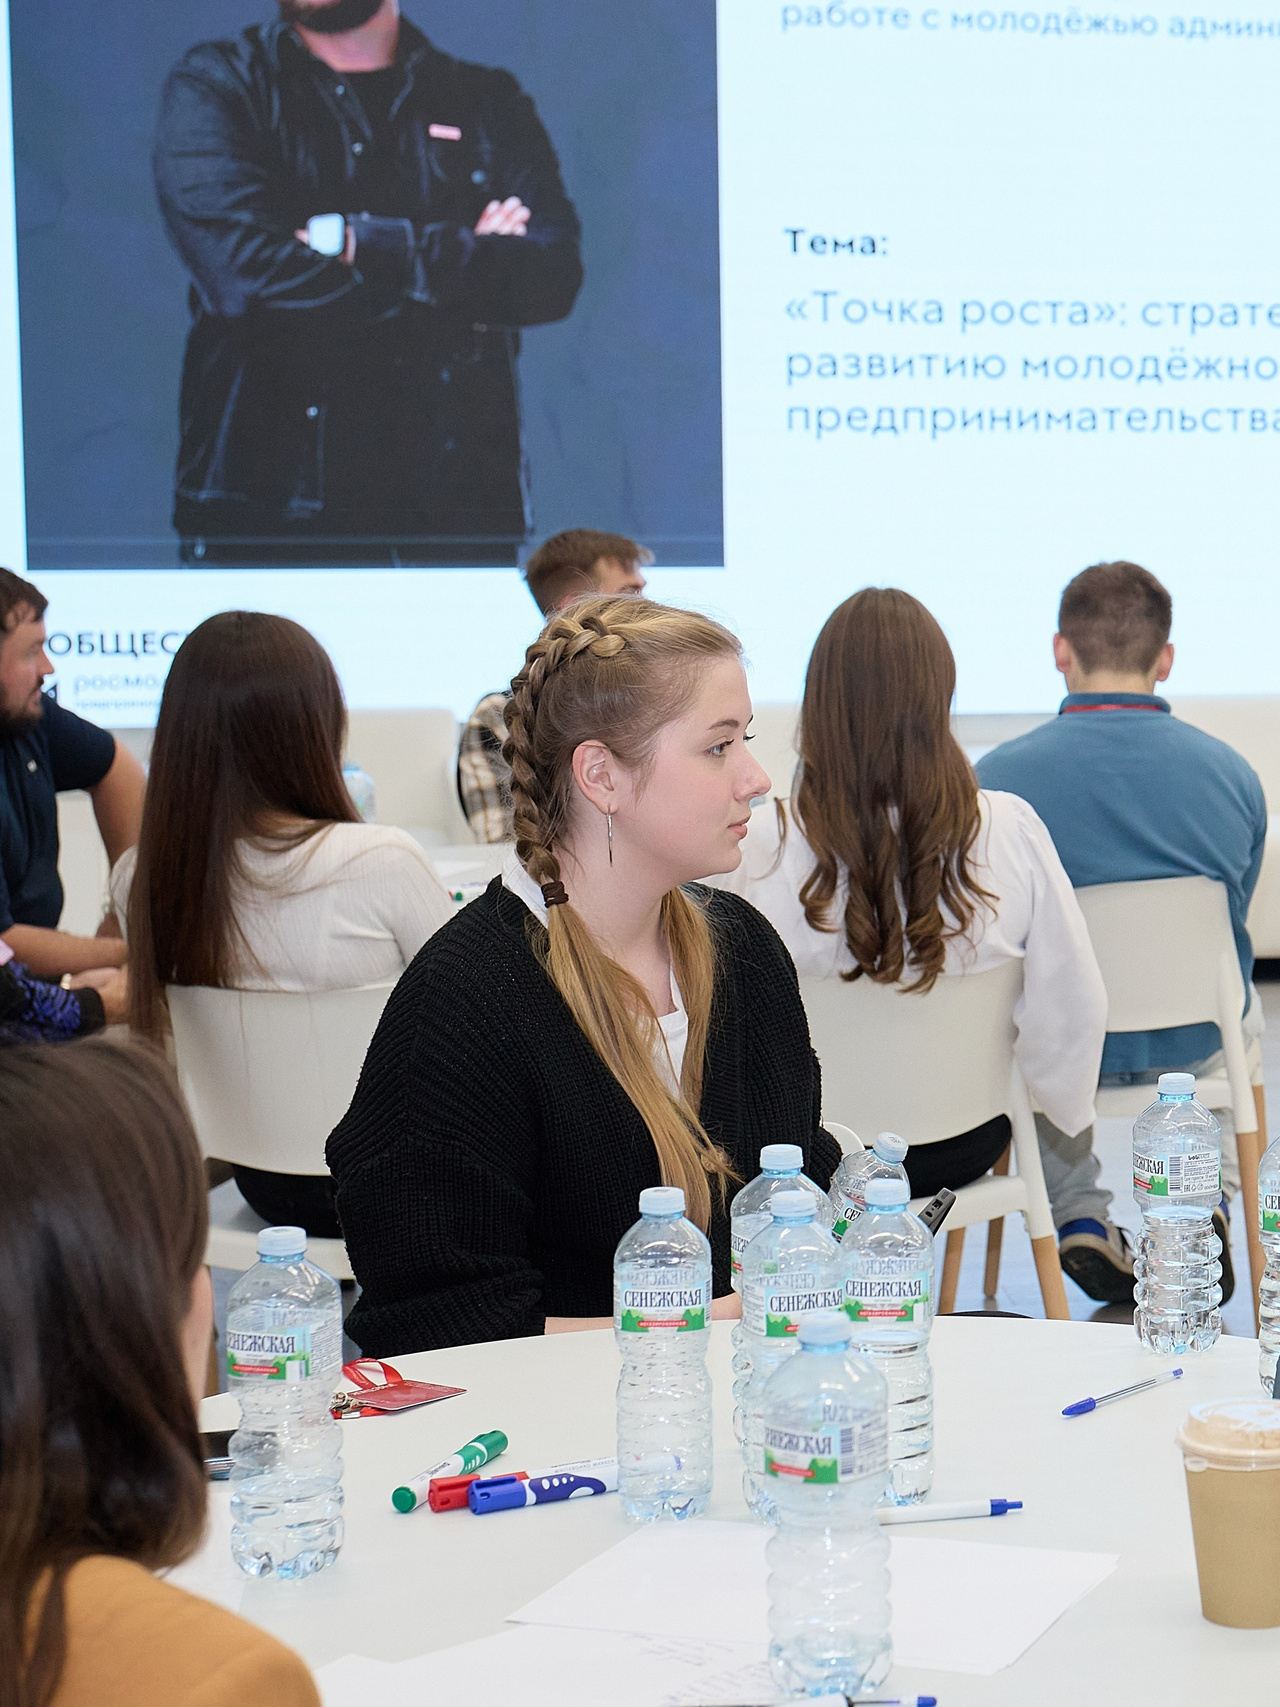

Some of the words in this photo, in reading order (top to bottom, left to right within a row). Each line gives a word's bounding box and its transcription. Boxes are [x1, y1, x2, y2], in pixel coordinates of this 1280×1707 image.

[781, 1, 912, 33] работе
[920, 8, 940, 31] с
[950, 7, 1159, 37] молодёжью
[783, 227, 889, 257] Тема:
[784, 290, 945, 326] «Точка
[960, 299, 1127, 335] роста»:
[786, 351, 1008, 387] развитию
[48, 632, 190, 659] ОБЩЕС
[74, 674, 161, 696] росмо
[624, 1288, 702, 1308] СЕНЕЖСКАЯ
[769, 1288, 843, 1314] СЕНЕЖСКАЯ
[845, 1279, 922, 1298] СЕНЕЖСКАЯ
